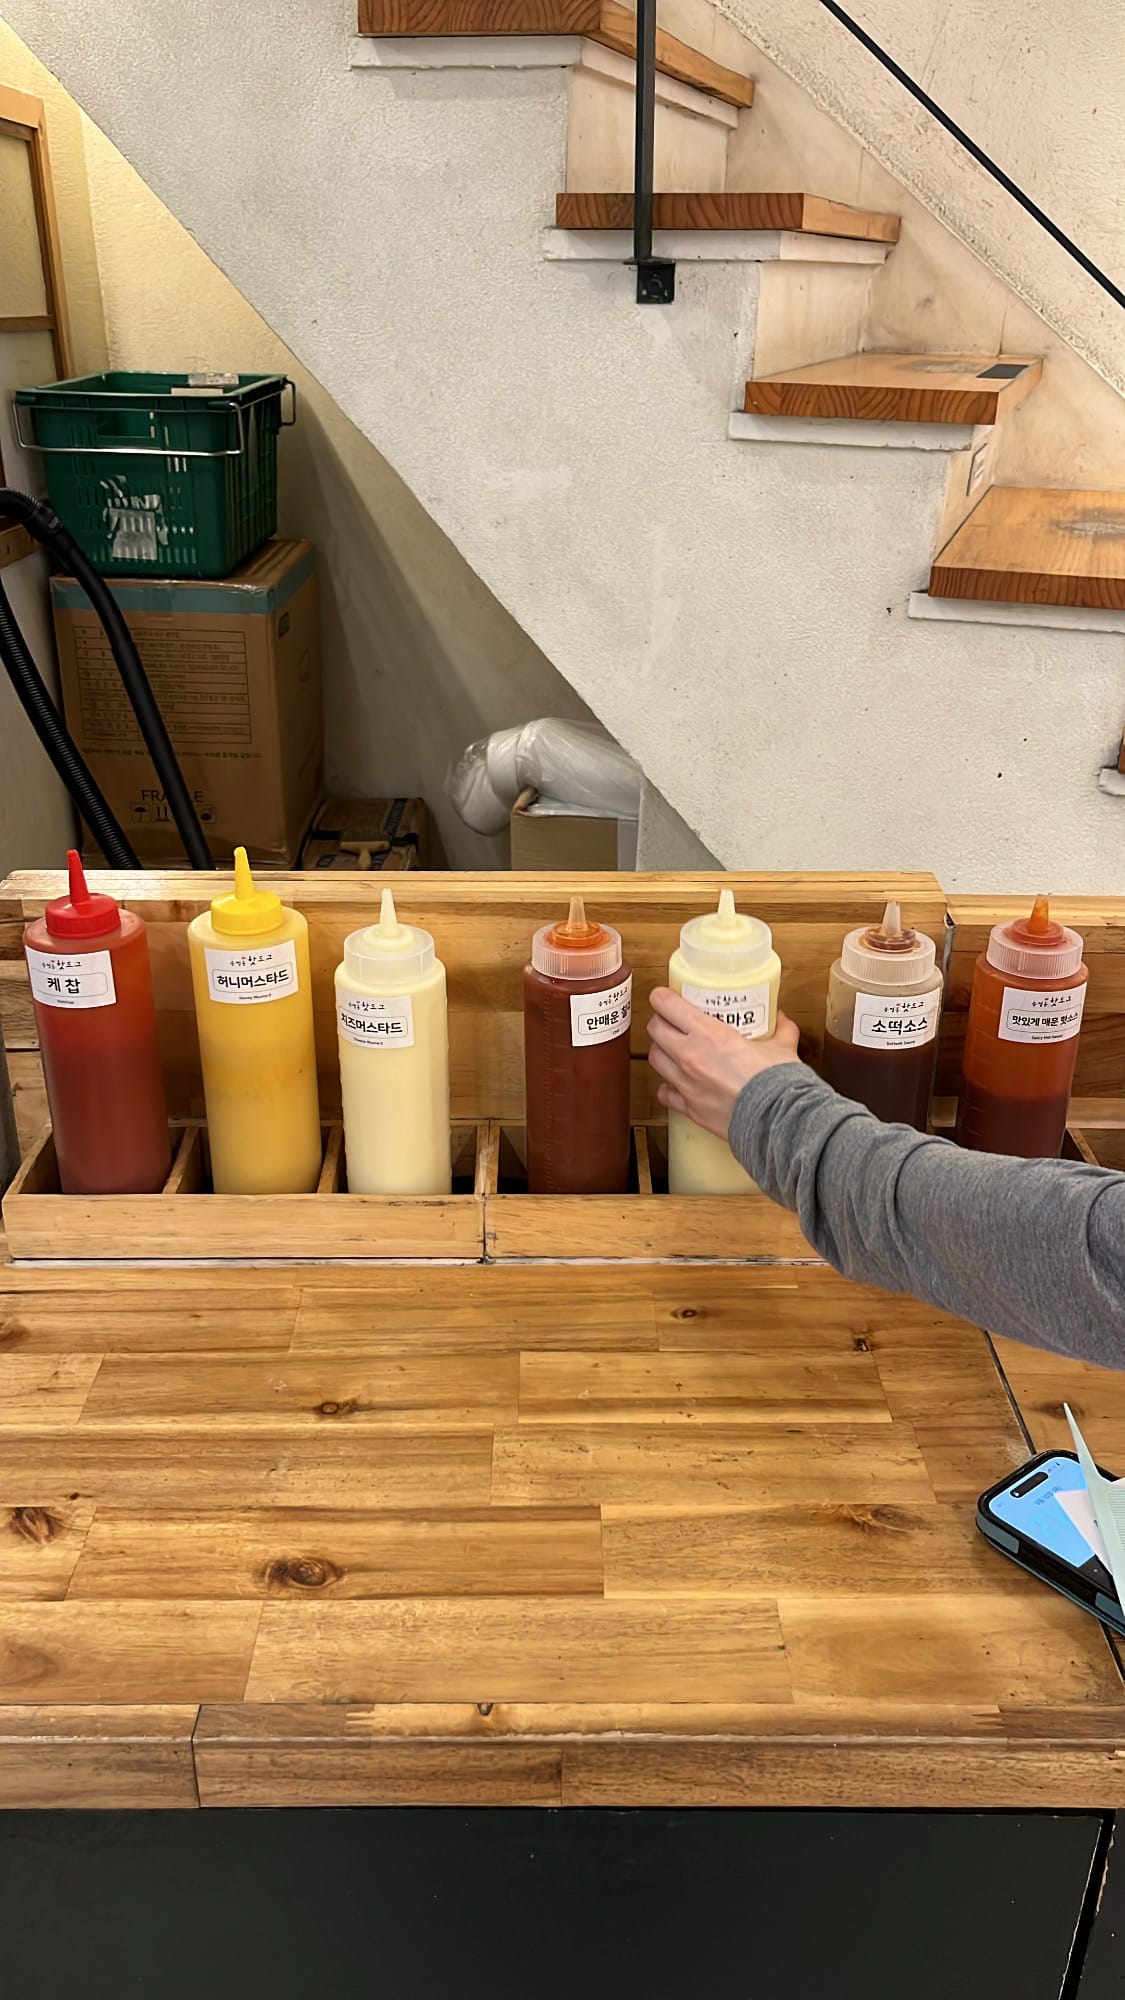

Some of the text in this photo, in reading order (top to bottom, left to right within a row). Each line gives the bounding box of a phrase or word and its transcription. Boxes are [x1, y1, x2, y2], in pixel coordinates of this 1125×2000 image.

[216, 969, 289, 989] 허니머스타드
[341, 1012, 403, 1034] 치즈머스타드
[586, 1010, 620, 1031] 안매운
[871, 1017, 928, 1036] 소떡소스
[1012, 1015, 1040, 1027] 맛있게
[1041, 1017, 1059, 1027] 매운
